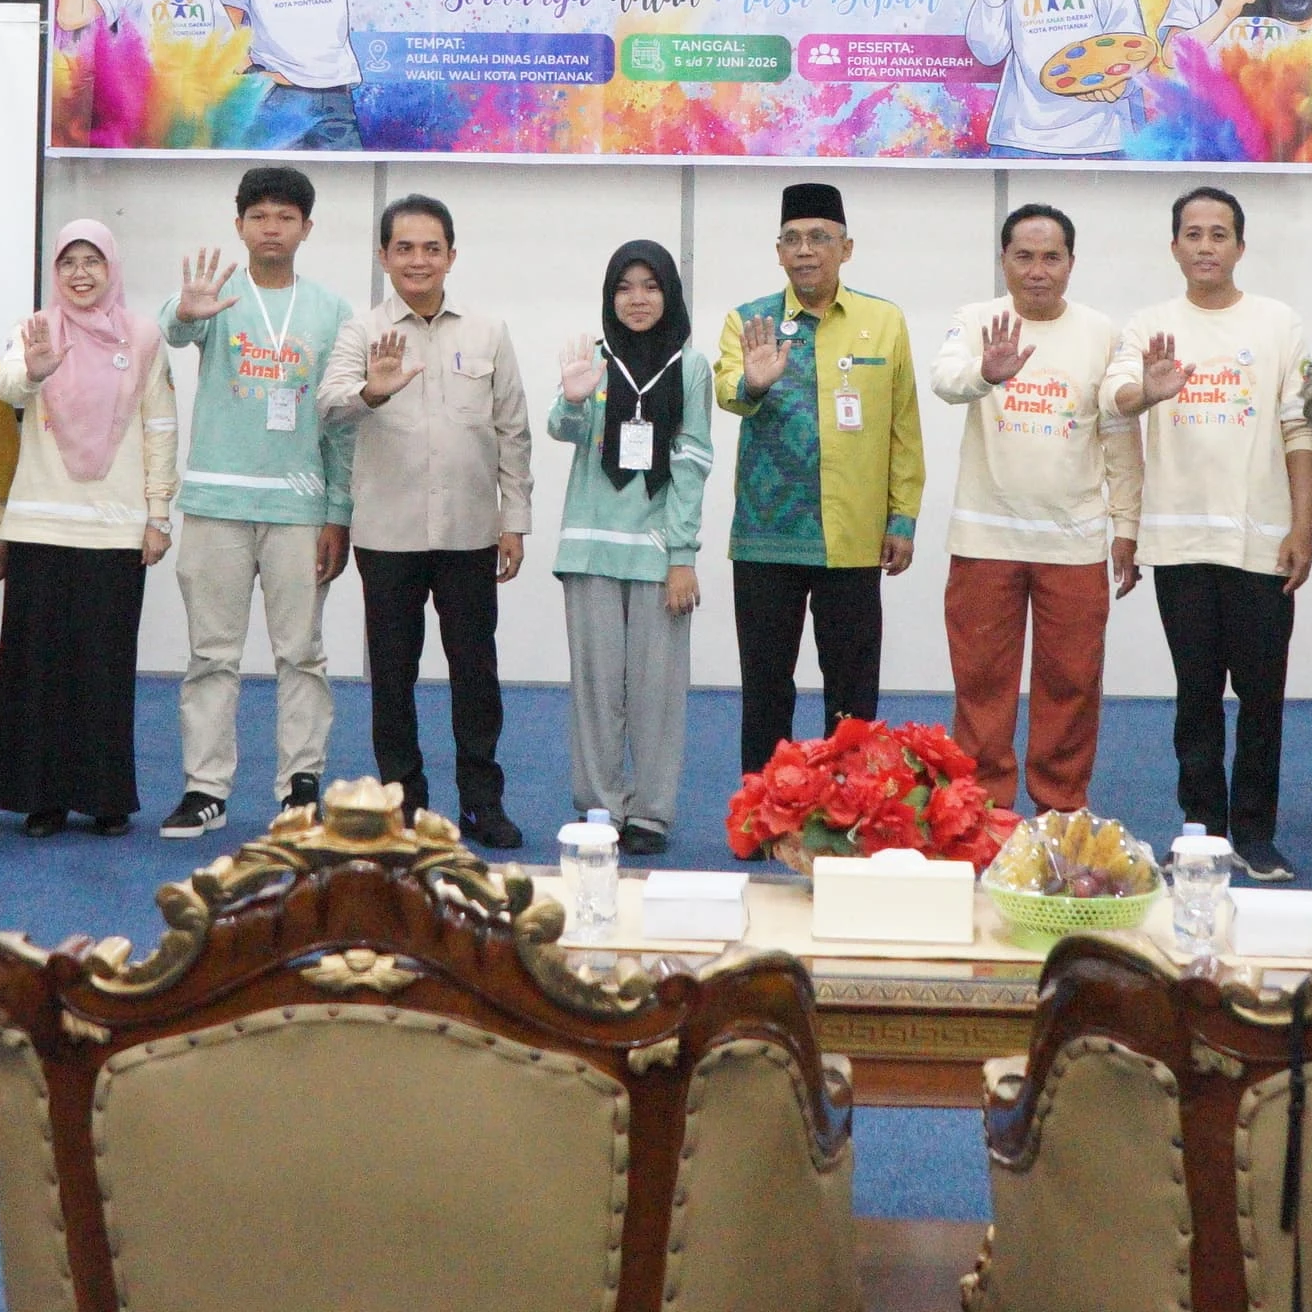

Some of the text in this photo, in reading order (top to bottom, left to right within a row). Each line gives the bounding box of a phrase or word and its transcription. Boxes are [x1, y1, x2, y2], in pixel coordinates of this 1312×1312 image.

[405, 37, 466, 50] TEMPAT:
[671, 40, 746, 53] TANGGAL:
[848, 41, 915, 54] PESERTA:
[405, 53, 590, 66] AULA RUMAH DINAS JABATAN
[675, 55, 778, 68] 5 s/d 7 JUNI 2026
[847, 55, 974, 67] FORUM ANAK DAERAH
[405, 70, 593, 82] WAKIL WALI KOTA PONTIANAK
[847, 66, 947, 78] KOTA PONTIANAK
[240, 340, 301, 365] Forum
[1188, 369, 1241, 386] orum
[1003, 375, 1068, 399] Forum
[1177, 387, 1227, 404] Anak
[1003, 394, 1053, 415] Anak
[1172, 412, 1246, 427] Pontianak
[998, 419, 1069, 440] Pontianak
